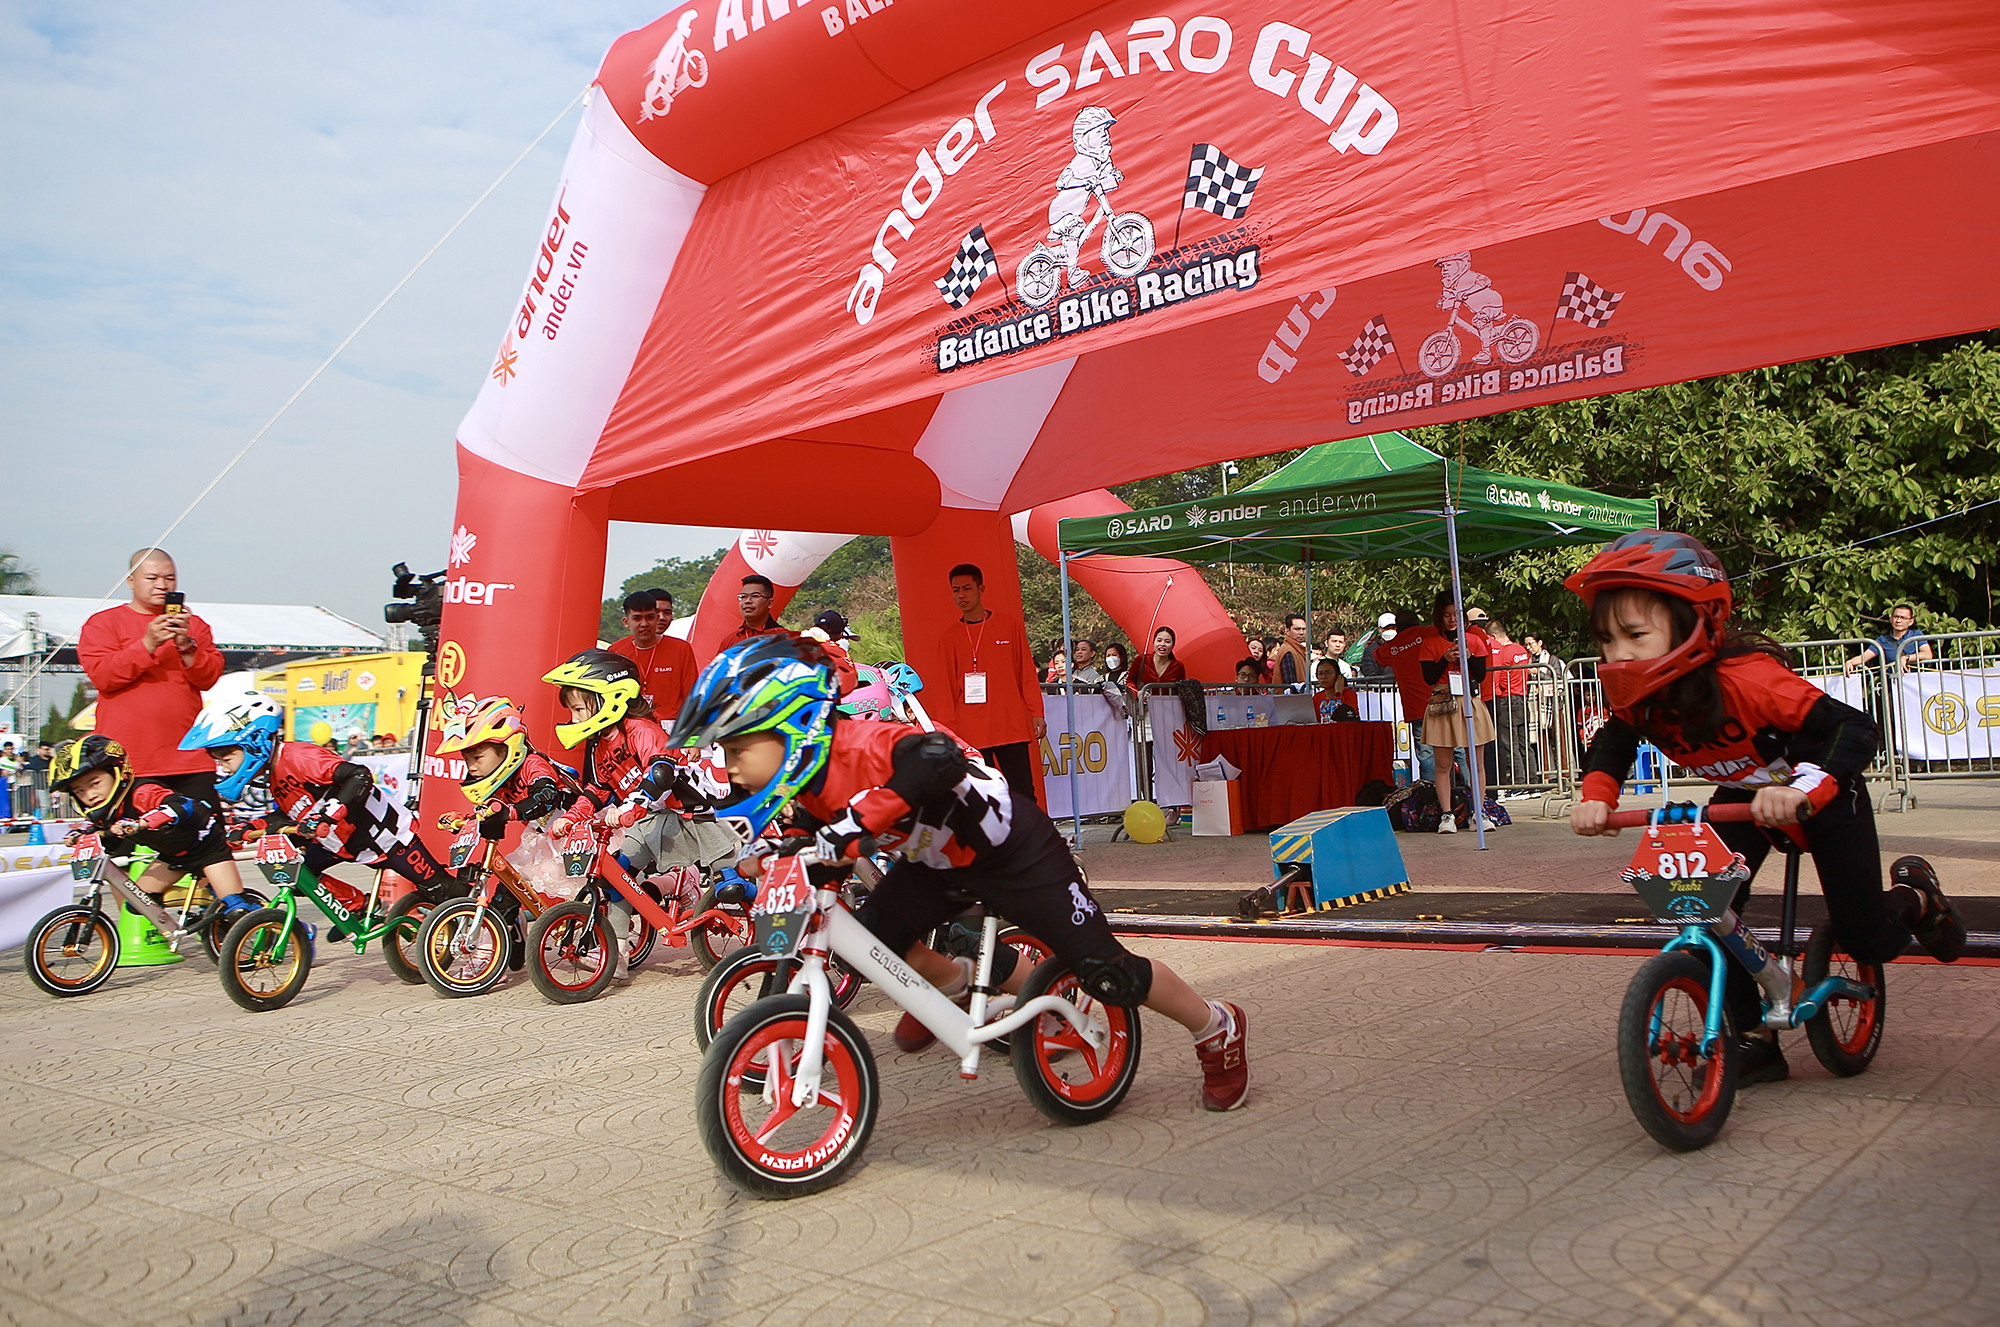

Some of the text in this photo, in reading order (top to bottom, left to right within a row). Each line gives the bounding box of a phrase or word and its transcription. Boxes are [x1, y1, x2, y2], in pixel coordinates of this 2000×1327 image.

[846, 16, 1400, 325] ander SARO Cup
[516, 186, 570, 339] ander
[541, 240, 589, 341] ander.vn
[938, 250, 1259, 370] Balance Bike Racing
[1126, 491, 1377, 535] SARO ander ander.vn
[1500, 488, 1633, 528] SARO ander ander.vn
[266, 849, 288, 864] 813
[569, 839, 588, 855] 807
[1658, 851, 1709, 879] 812
[313, 883, 351, 922] SARO
[621, 871, 645, 896] ander
[766, 884, 797, 915] 823
[869, 946, 919, 989] ander
